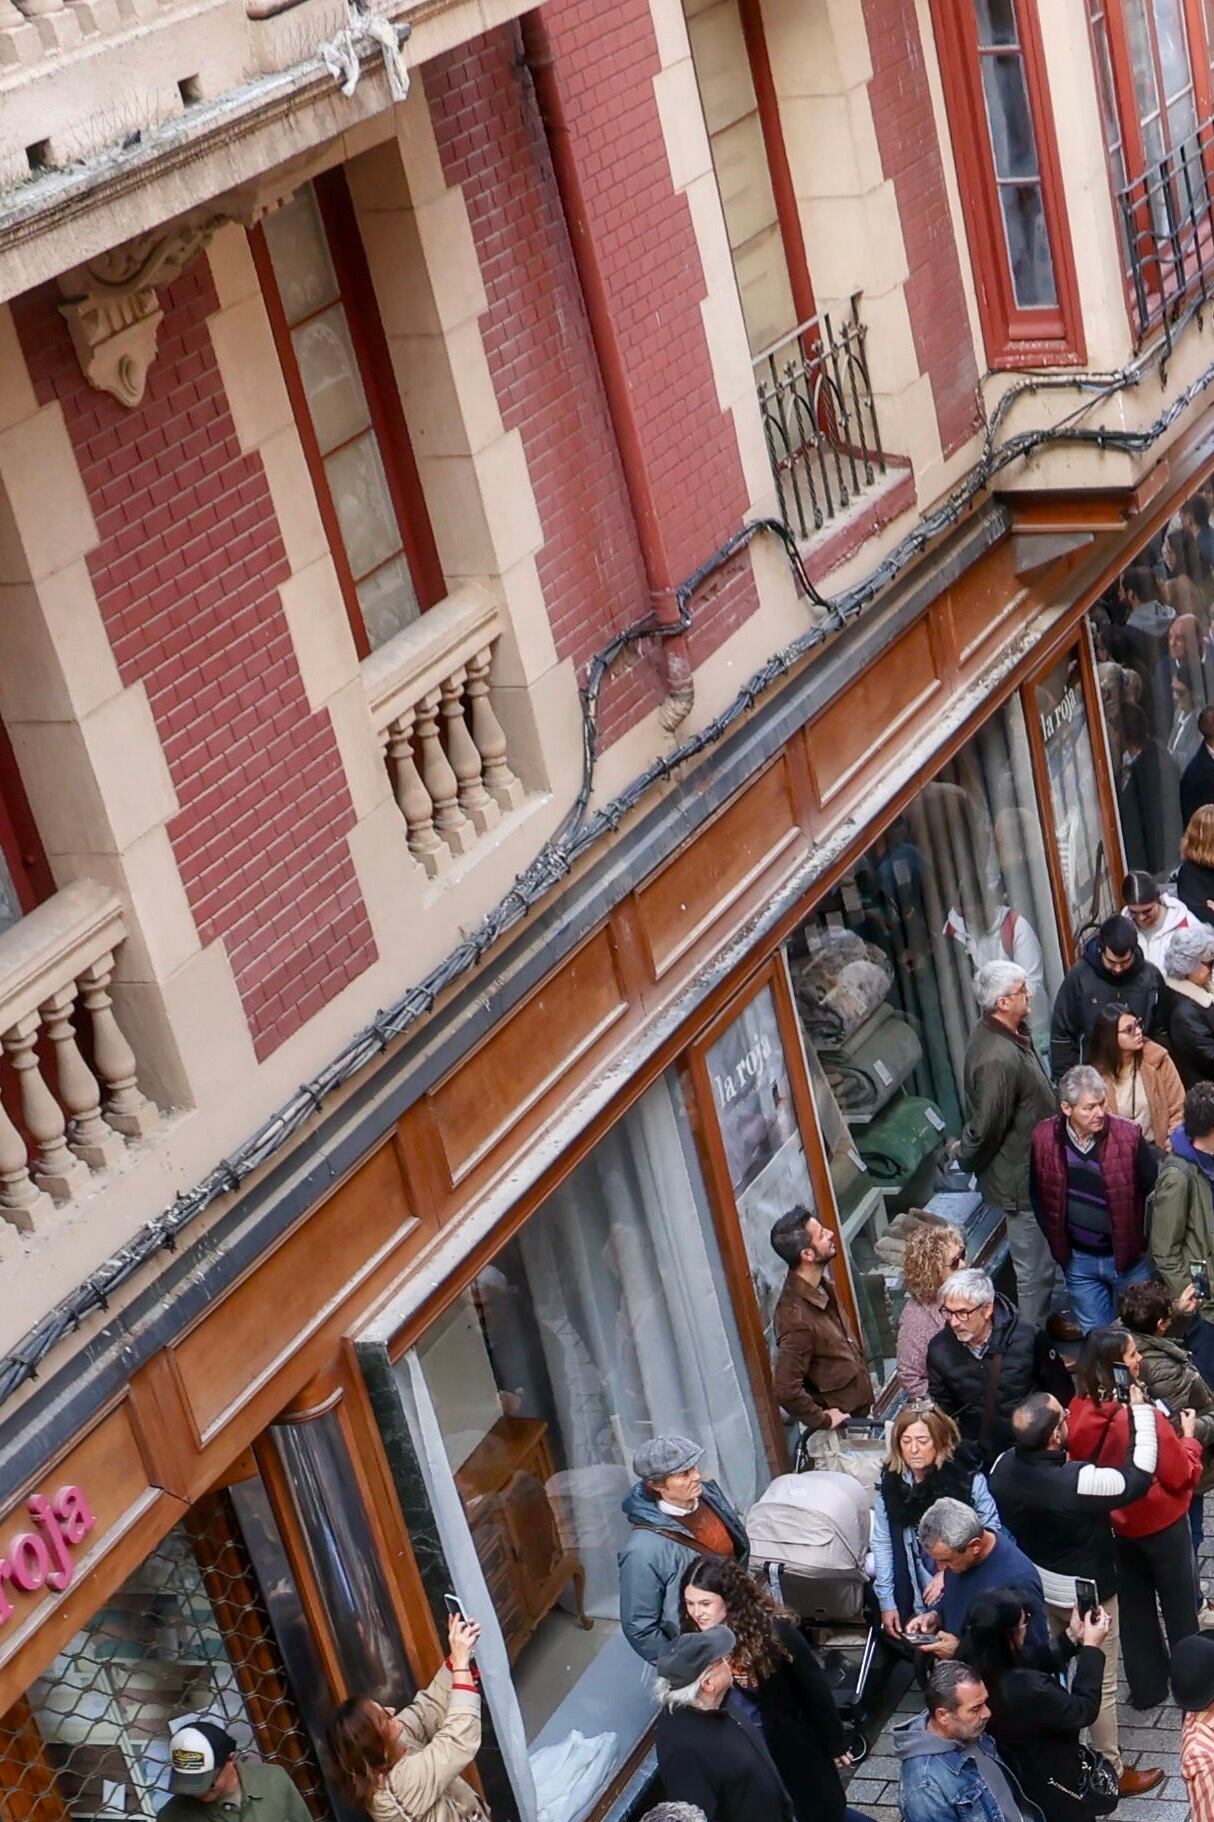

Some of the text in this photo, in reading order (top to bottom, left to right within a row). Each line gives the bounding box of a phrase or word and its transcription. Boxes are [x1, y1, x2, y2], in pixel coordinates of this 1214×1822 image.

[1040, 685, 1076, 741] la roja
[715, 1033, 772, 1109] la roja
